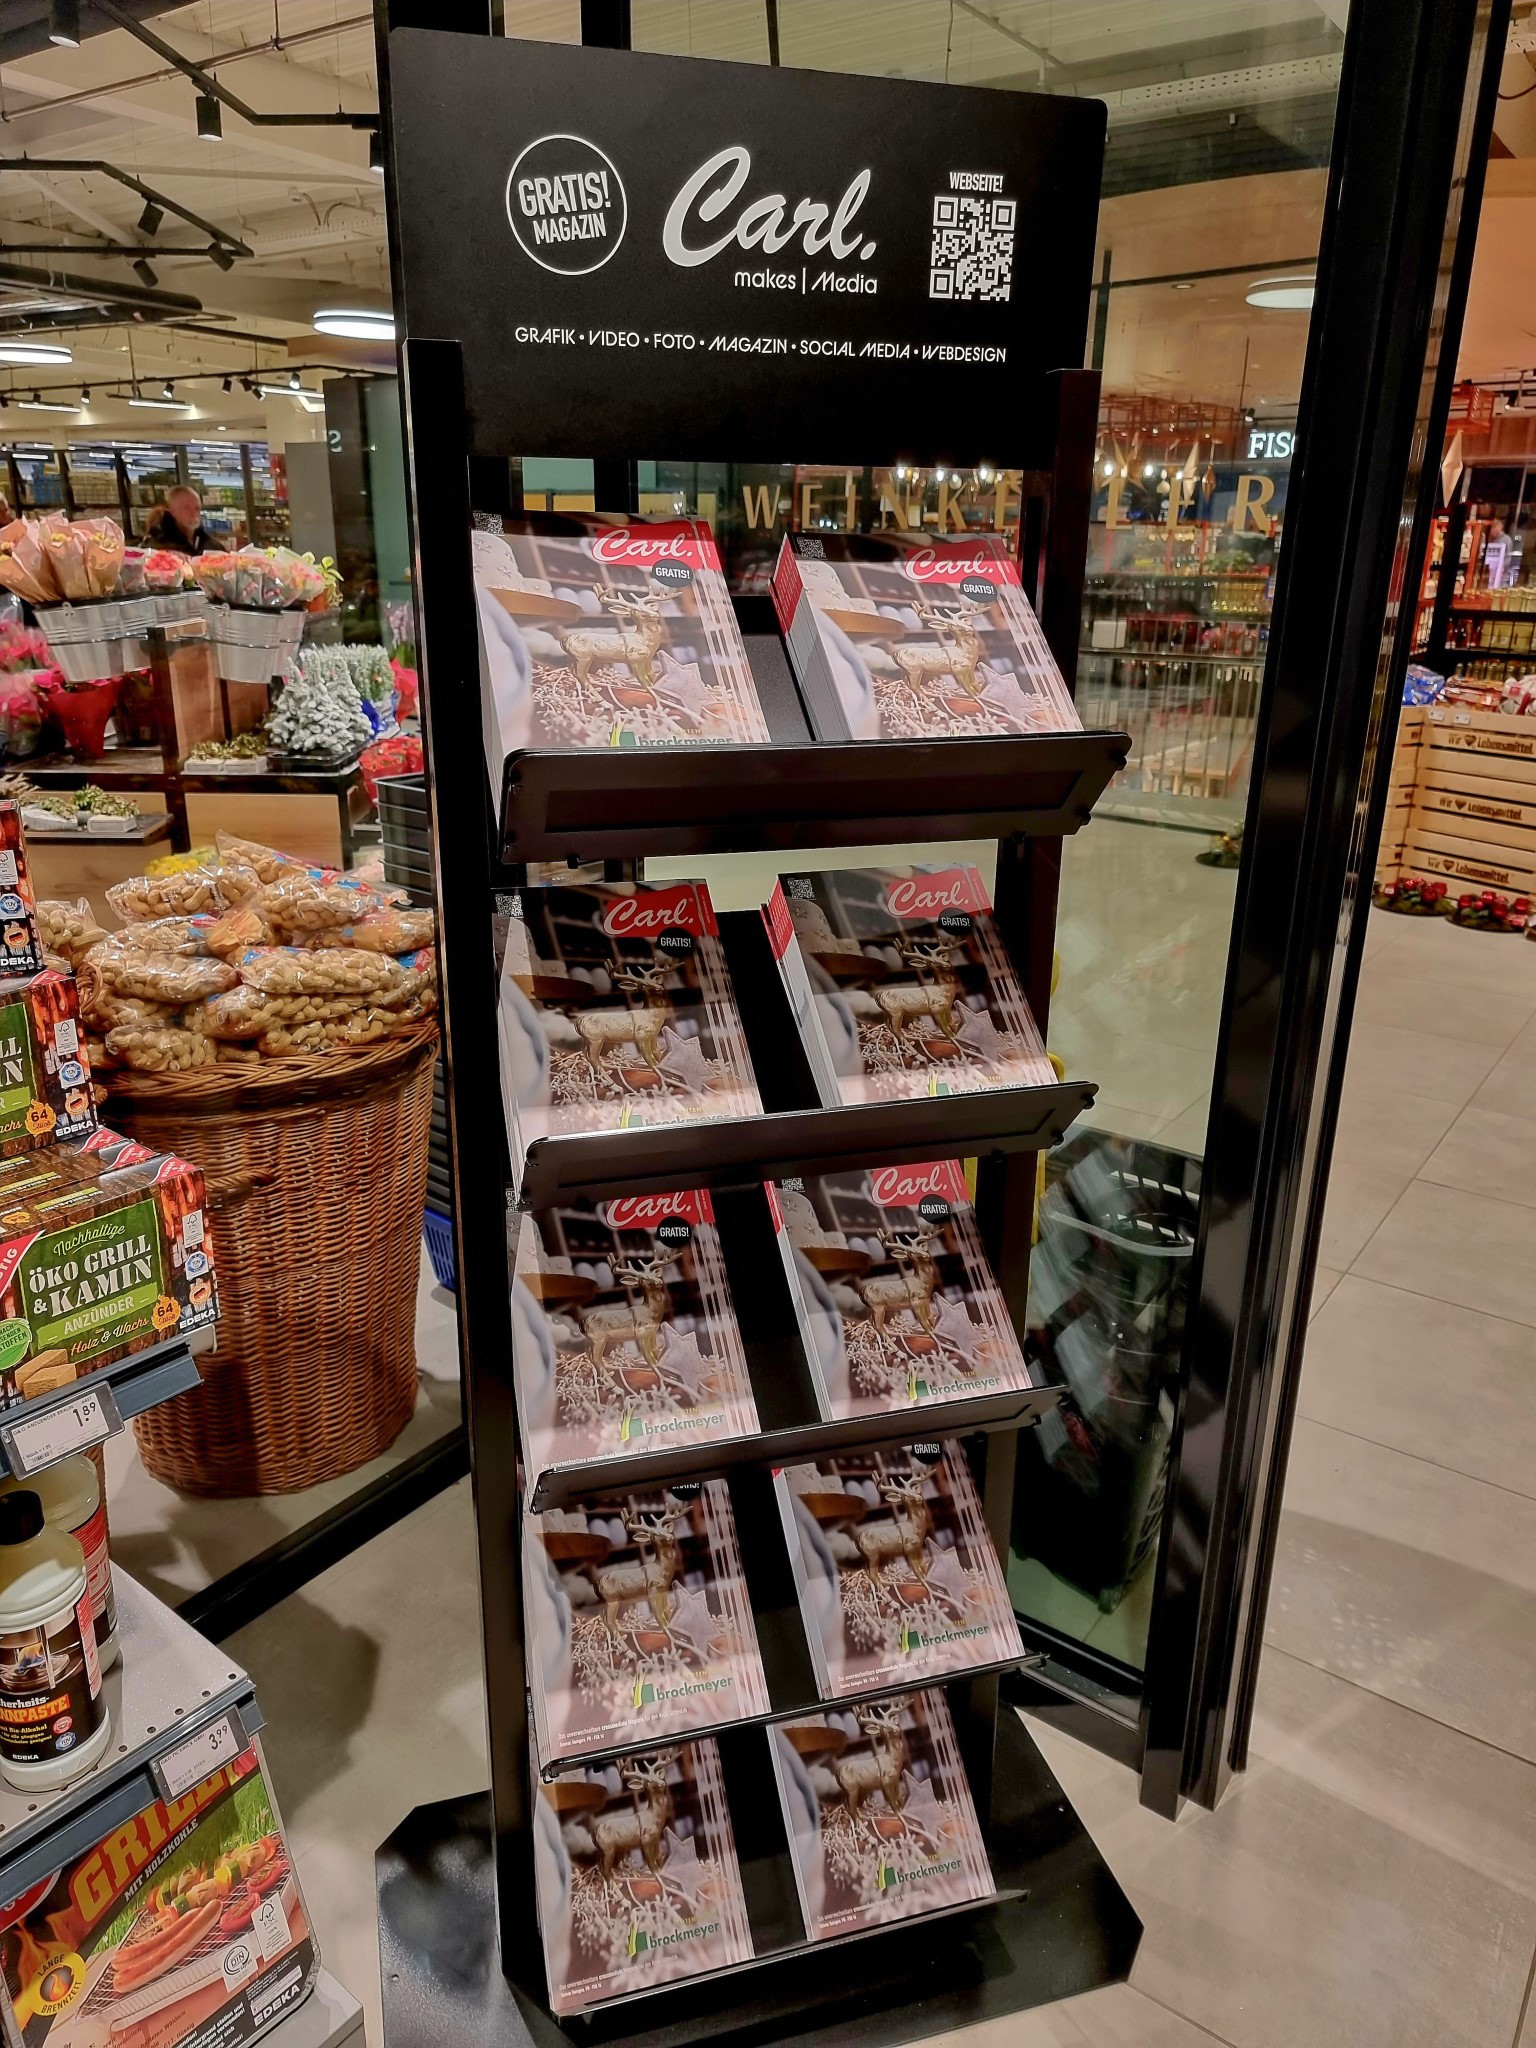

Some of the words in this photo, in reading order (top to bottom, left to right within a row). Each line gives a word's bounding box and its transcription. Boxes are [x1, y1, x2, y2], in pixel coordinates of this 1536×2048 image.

[518, 171, 612, 217] GRATIS!
[950, 171, 1004, 194] WEBSEITE!
[663, 146, 878, 267] Carl.
[533, 212, 607, 245] MAGAZIN
[734, 268, 796, 290] makes
[811, 271, 878, 294] Media
[515, 326, 575, 345] GRAFIK
[588, 329, 640, 347] VIDEO
[654, 333, 695, 350] FOTO
[708, 335, 788, 354] MAGAZIN
[800, 339, 856, 357] SOCIAL
[859, 341, 910, 359] MEDIA
[921, 344, 1007, 363] WEBDESIGN
[1247, 432, 1295, 458] FIS
[742, 474, 1276, 532] WEINKELER
[592, 529, 694, 561] Carl.
[656, 567, 690, 579] GRATIS!
[905, 549, 994, 580] Carl.
[963, 583, 995, 595] GRATIS!
[887, 881, 970, 916] Carl.
[603, 898, 694, 935] Carl.
[941, 917, 970, 927] GRATIS!
[660, 937, 692, 948] GRATIS!
[31, 1109, 48, 1122] 64
[56, 1120, 94, 1137] EDEKA
[872, 1168, 948, 1206] Carl.
[921, 1204, 949, 1215] GRATIS!
[53, 1224, 126, 1256] Nachhaltige
[659, 1227, 689, 1238] GRATIS!
[29, 1261, 79, 1294] ÖKO
[84, 1235, 151, 1274] GRILL
[33, 1299, 48, 1315] &
[49, 1255, 153, 1318] KAMIN
[64, 1296, 135, 1335] ANZÜNDER
[157, 1303, 173, 1317] 64
[179, 1309, 216, 1329] EDEKA
[71, 1339, 101, 1356] Holz
[101, 1331, 112, 1343] &
[113, 1317, 150, 1338] Wachs
[929, 1375, 1001, 1397] brockmeyer
[73, 1402, 96, 1428] 1.89
[645, 1413, 725, 1436] brockmeyer
[914, 1443, 941, 1455] GRATIS!
[921, 1625, 990, 1647] brockmeyer
[656, 1676, 733, 1702] brockmeyer
[208, 1725, 228, 1750] 3.99
[124, 1879, 143, 1902] MIT
[145, 1818, 200, 1880] HOLZKOHLE
[897, 1859, 962, 1884] brockmeyer
[649, 1922, 719, 1948] brockmeyer
[37, 1953, 65, 1977] LANGE
[41, 1980, 82, 2014] BRENNZEIT
[254, 1984, 300, 2026] EDEKA
